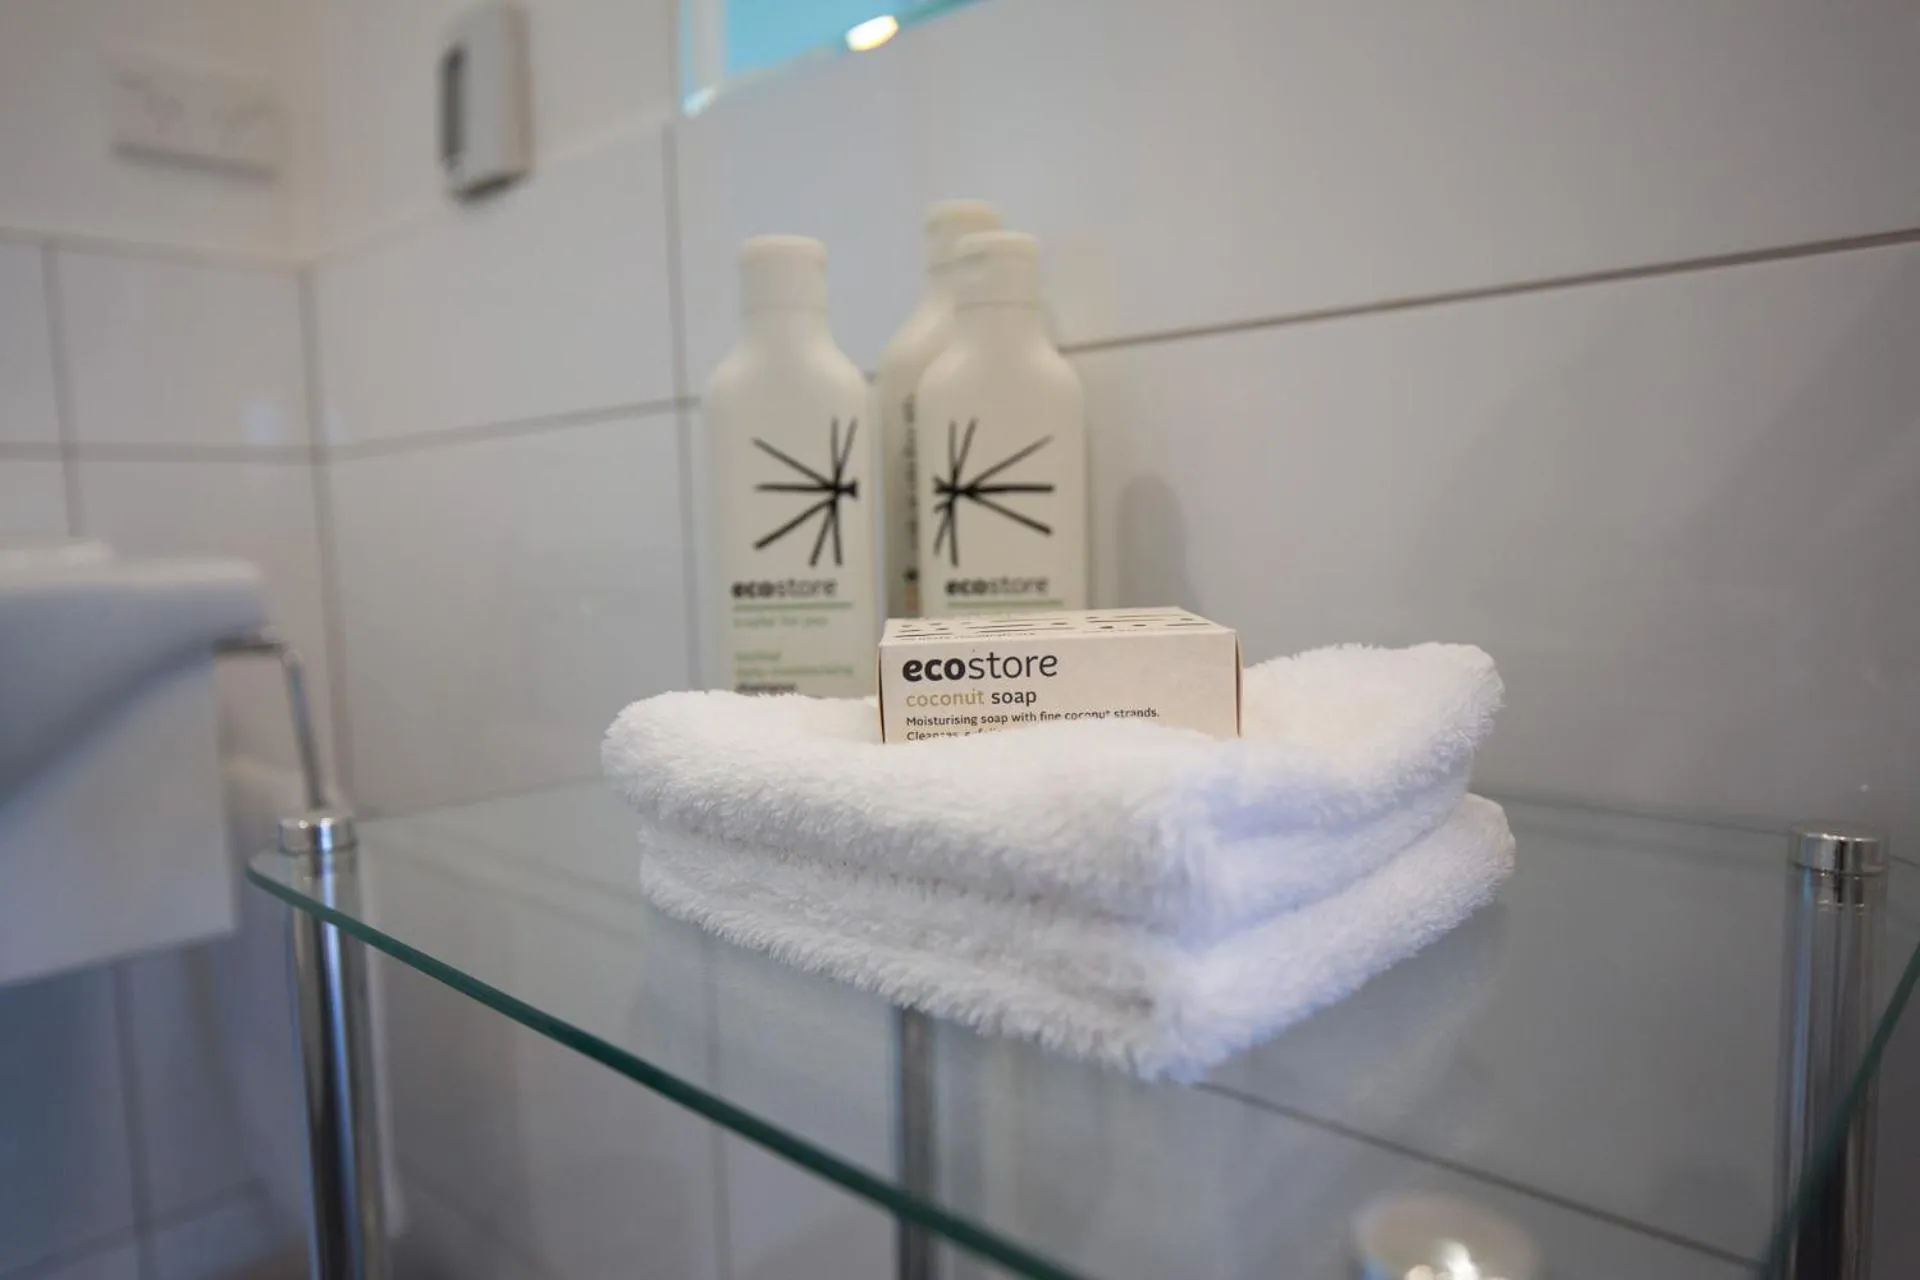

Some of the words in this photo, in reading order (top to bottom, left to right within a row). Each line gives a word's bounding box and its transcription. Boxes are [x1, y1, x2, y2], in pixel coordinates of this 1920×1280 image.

[731, 577, 838, 599] ecostore
[945, 576, 1048, 597] ecostore
[902, 651, 1058, 682] ecostore
[906, 690, 985, 707] coconut
[991, 691, 1037, 707] soap
[906, 714, 978, 726] Moisturising
[980, 714, 1008, 725] soap
[1011, 711, 1037, 722] with
[1040, 711, 1061, 721] fine
